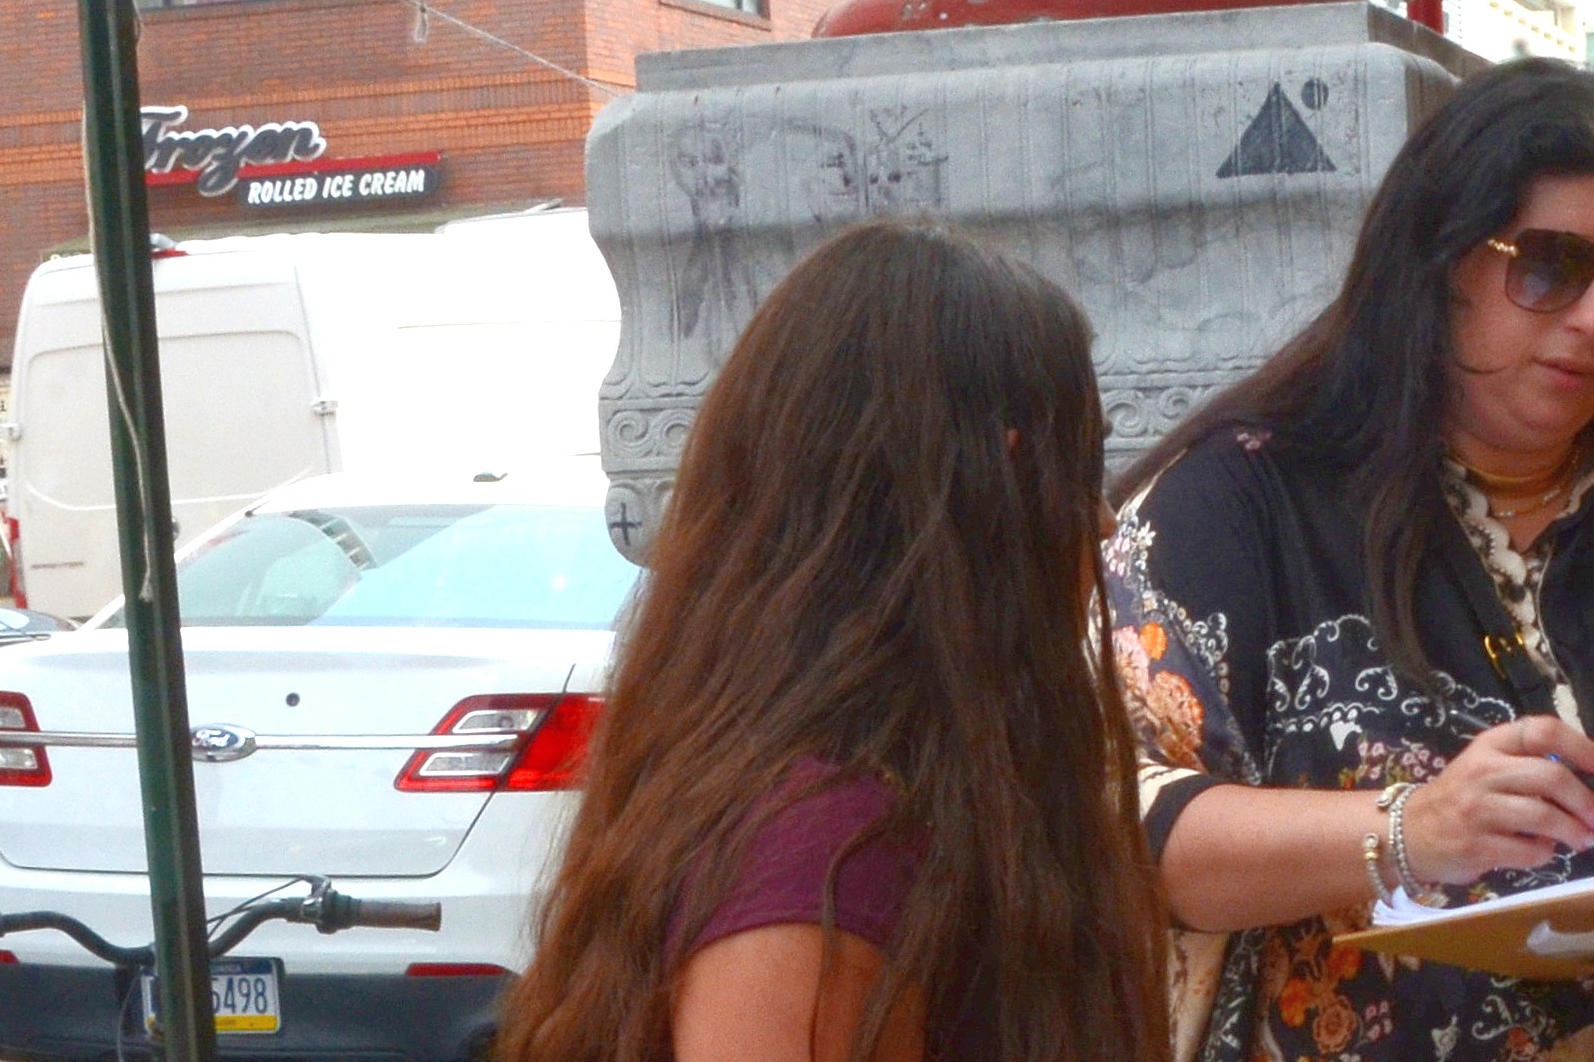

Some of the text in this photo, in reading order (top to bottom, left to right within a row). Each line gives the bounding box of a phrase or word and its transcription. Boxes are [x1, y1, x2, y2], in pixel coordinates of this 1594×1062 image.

[247, 168, 425, 205] ROLLED ICE CREAM
